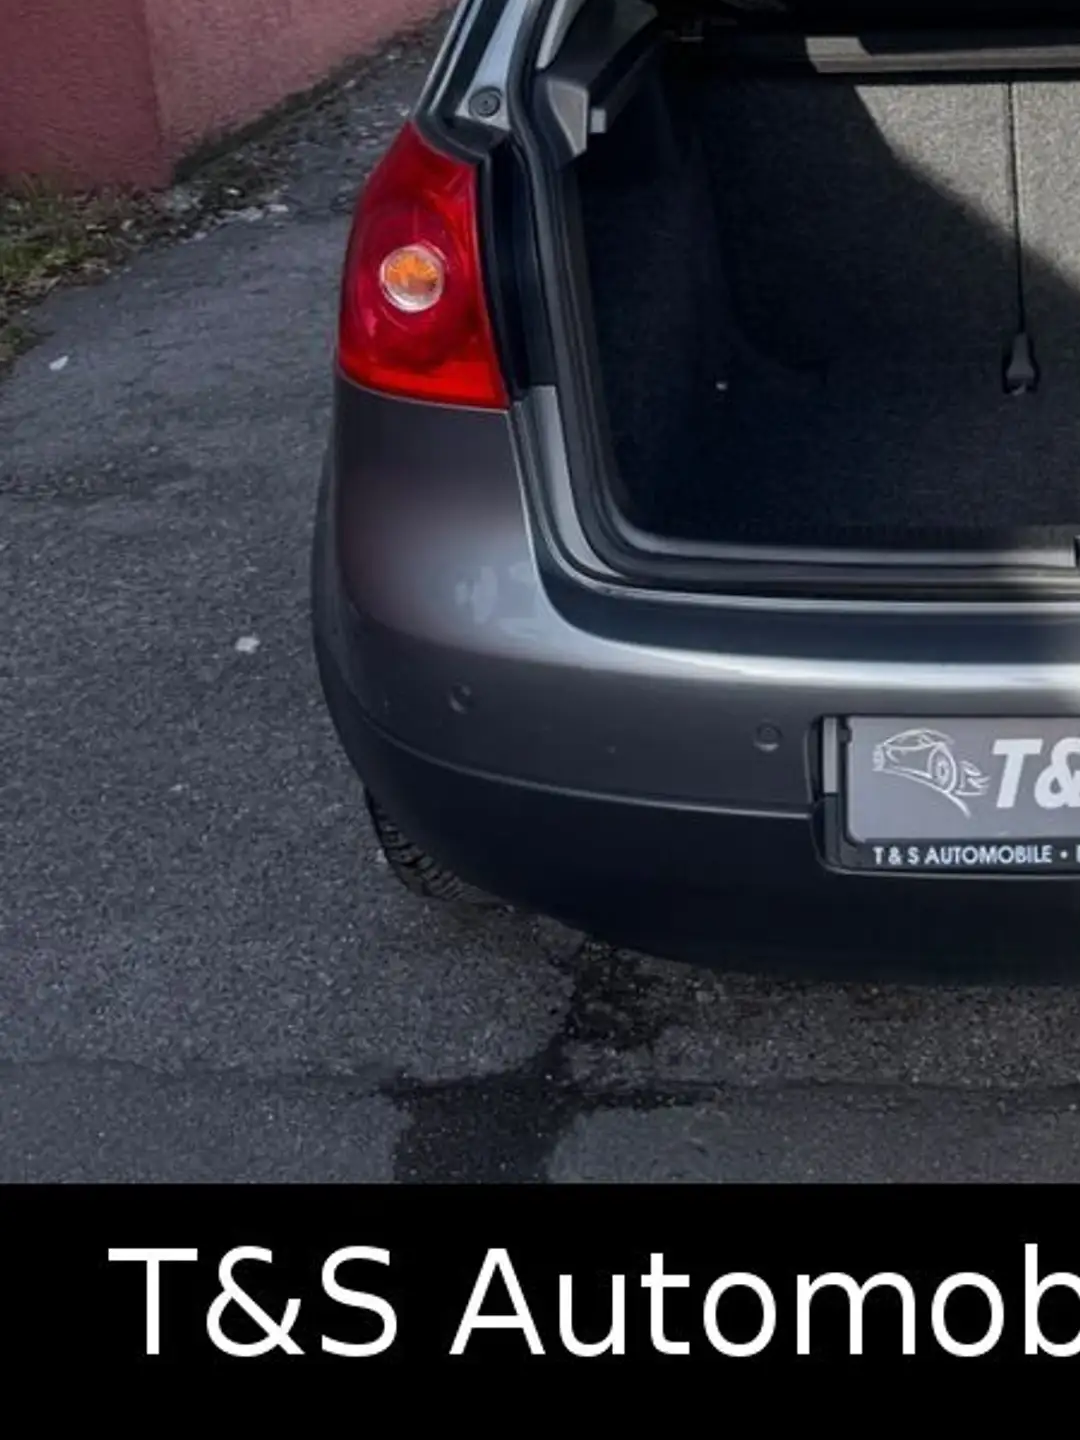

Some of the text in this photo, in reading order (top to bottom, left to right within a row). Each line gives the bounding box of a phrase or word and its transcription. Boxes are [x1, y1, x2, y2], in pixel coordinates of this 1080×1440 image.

[873, 846, 885, 865] T
[907, 846, 919, 865] S
[923, 844, 1053, 865] AUTOMOBILE
